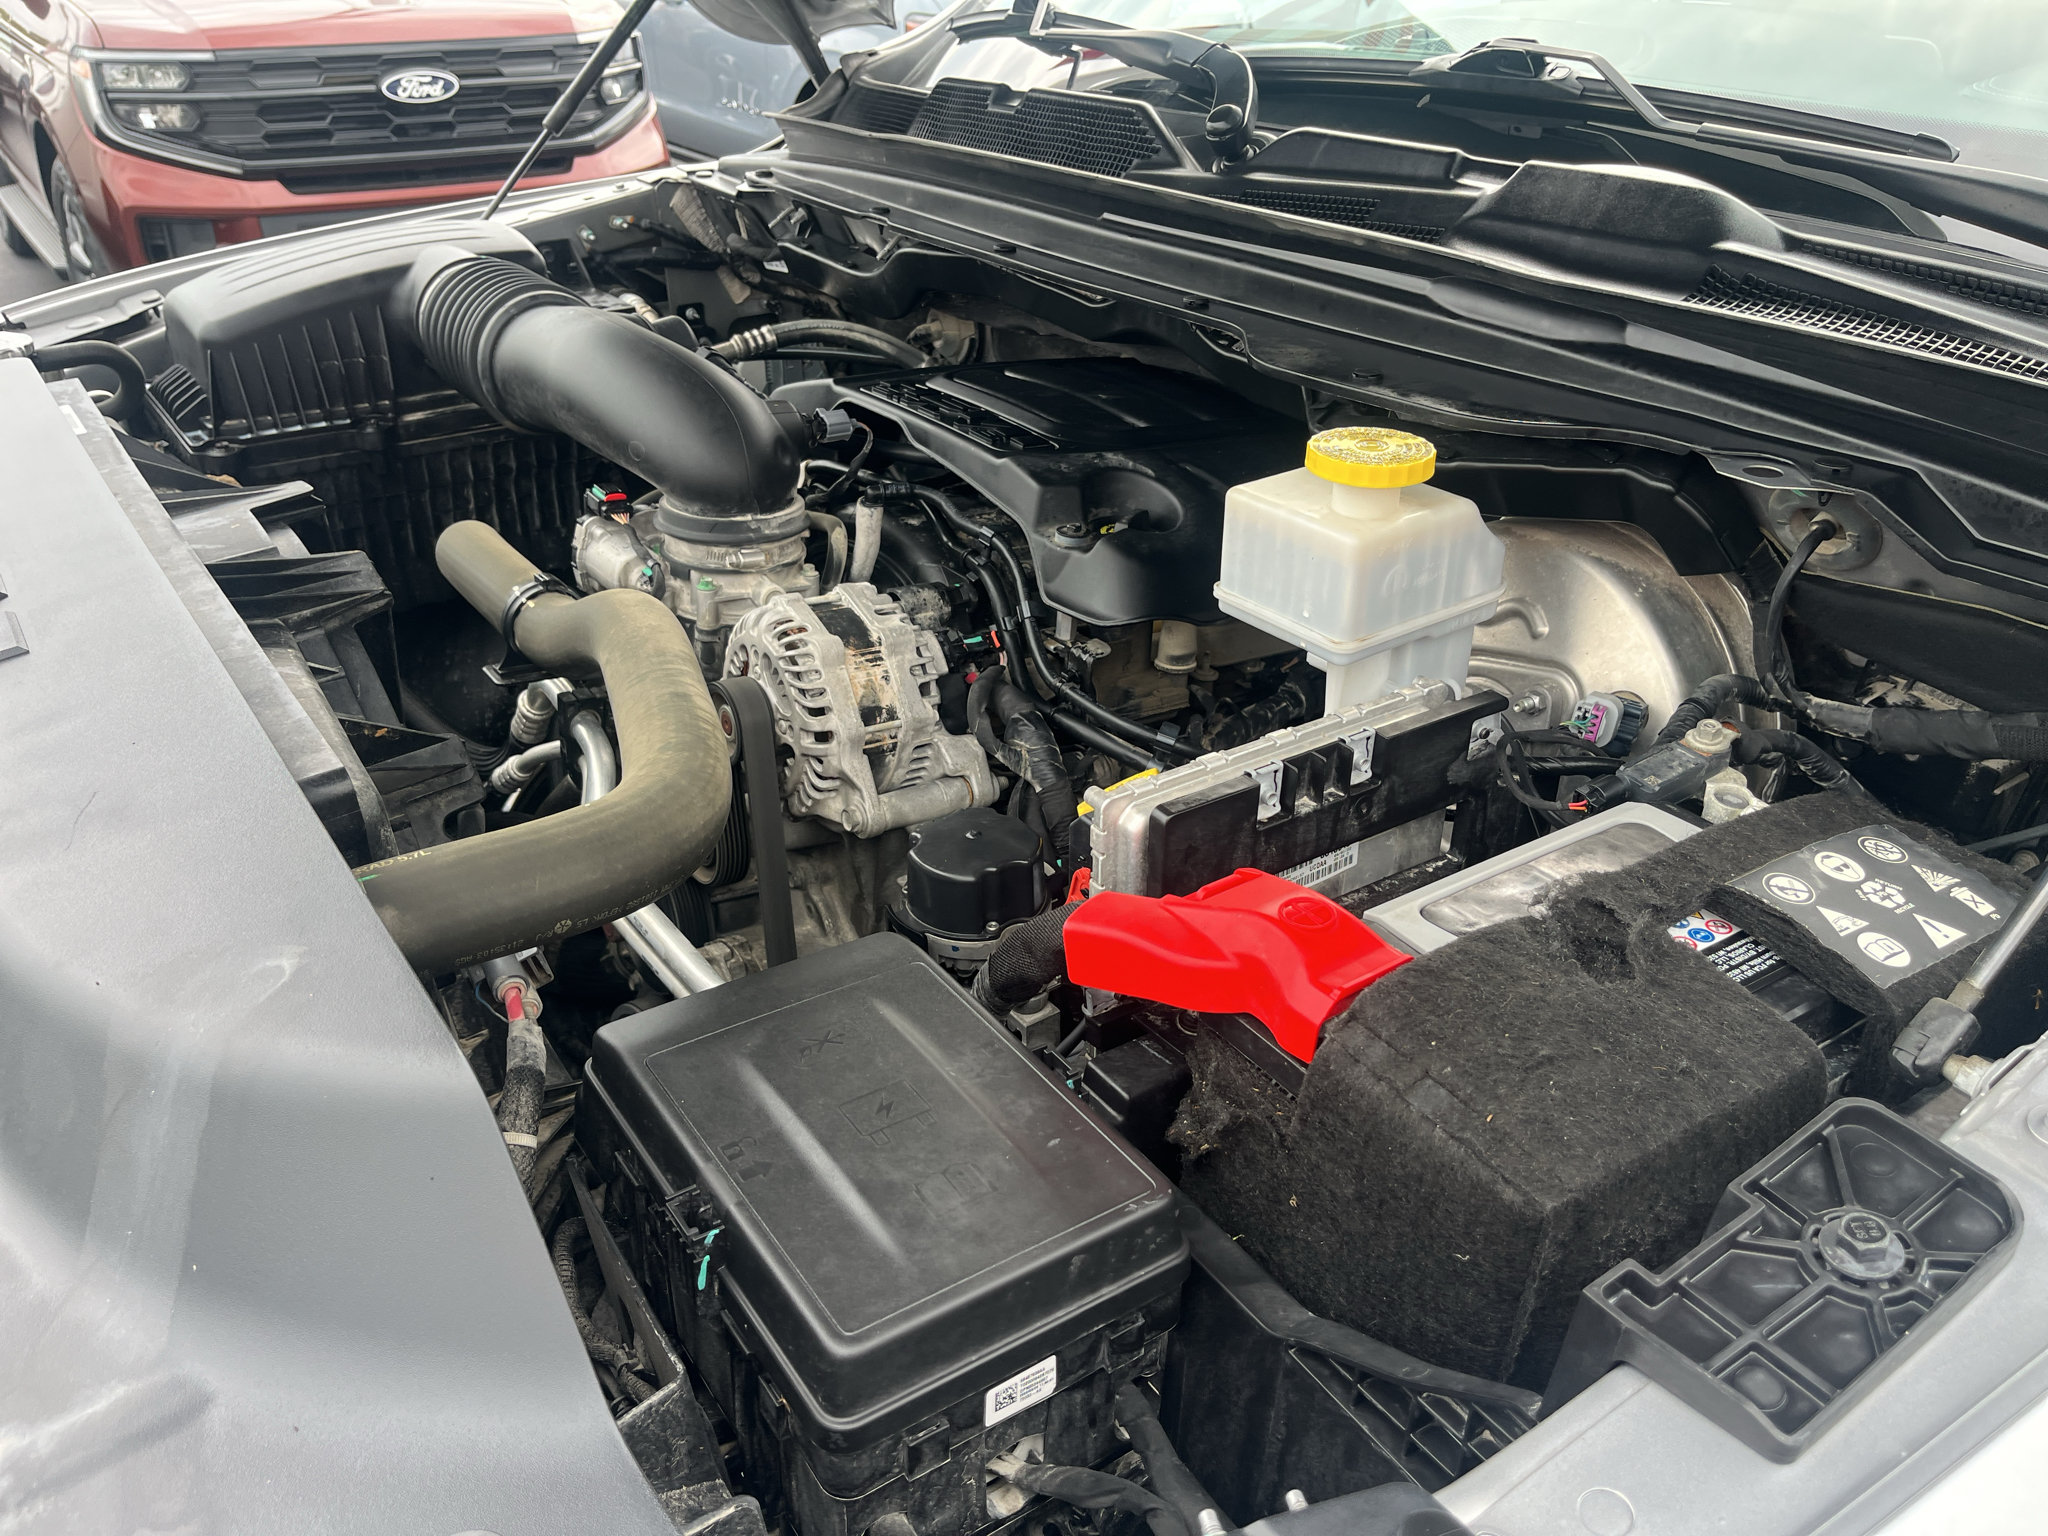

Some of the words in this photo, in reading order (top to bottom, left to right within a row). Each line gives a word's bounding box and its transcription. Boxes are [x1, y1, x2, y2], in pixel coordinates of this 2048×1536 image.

[397, 75, 445, 98] Ford
[1874, 878, 1903, 891] RETURN
[1714, 954, 1729, 965] LLC
[1754, 963, 1768, 972] FCA
[1732, 972, 1748, 983] LLC
